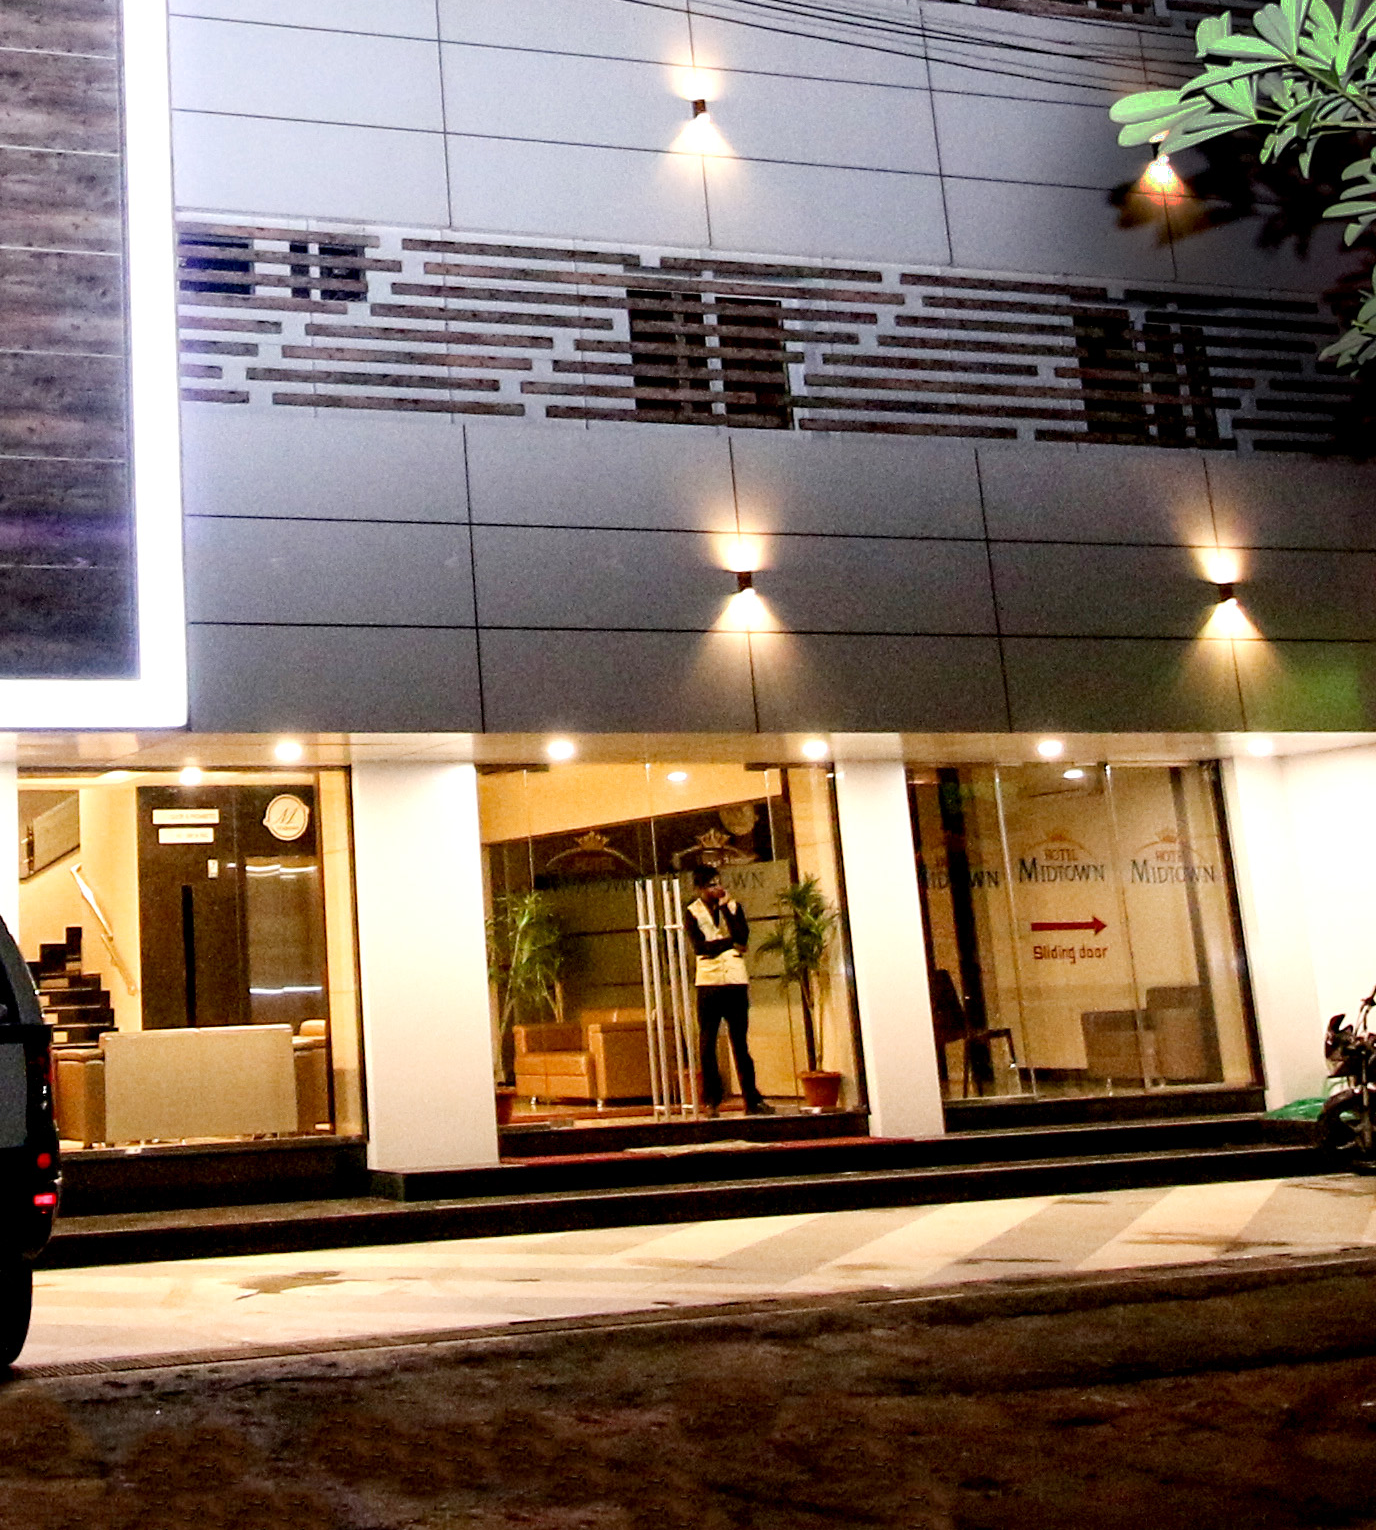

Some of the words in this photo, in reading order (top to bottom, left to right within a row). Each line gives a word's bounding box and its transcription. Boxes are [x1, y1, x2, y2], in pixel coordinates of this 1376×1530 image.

[1019, 857, 1105, 884] MIDTOWN
[1032, 945, 1076, 965] Sliding
[1079, 944, 1109, 959] door
